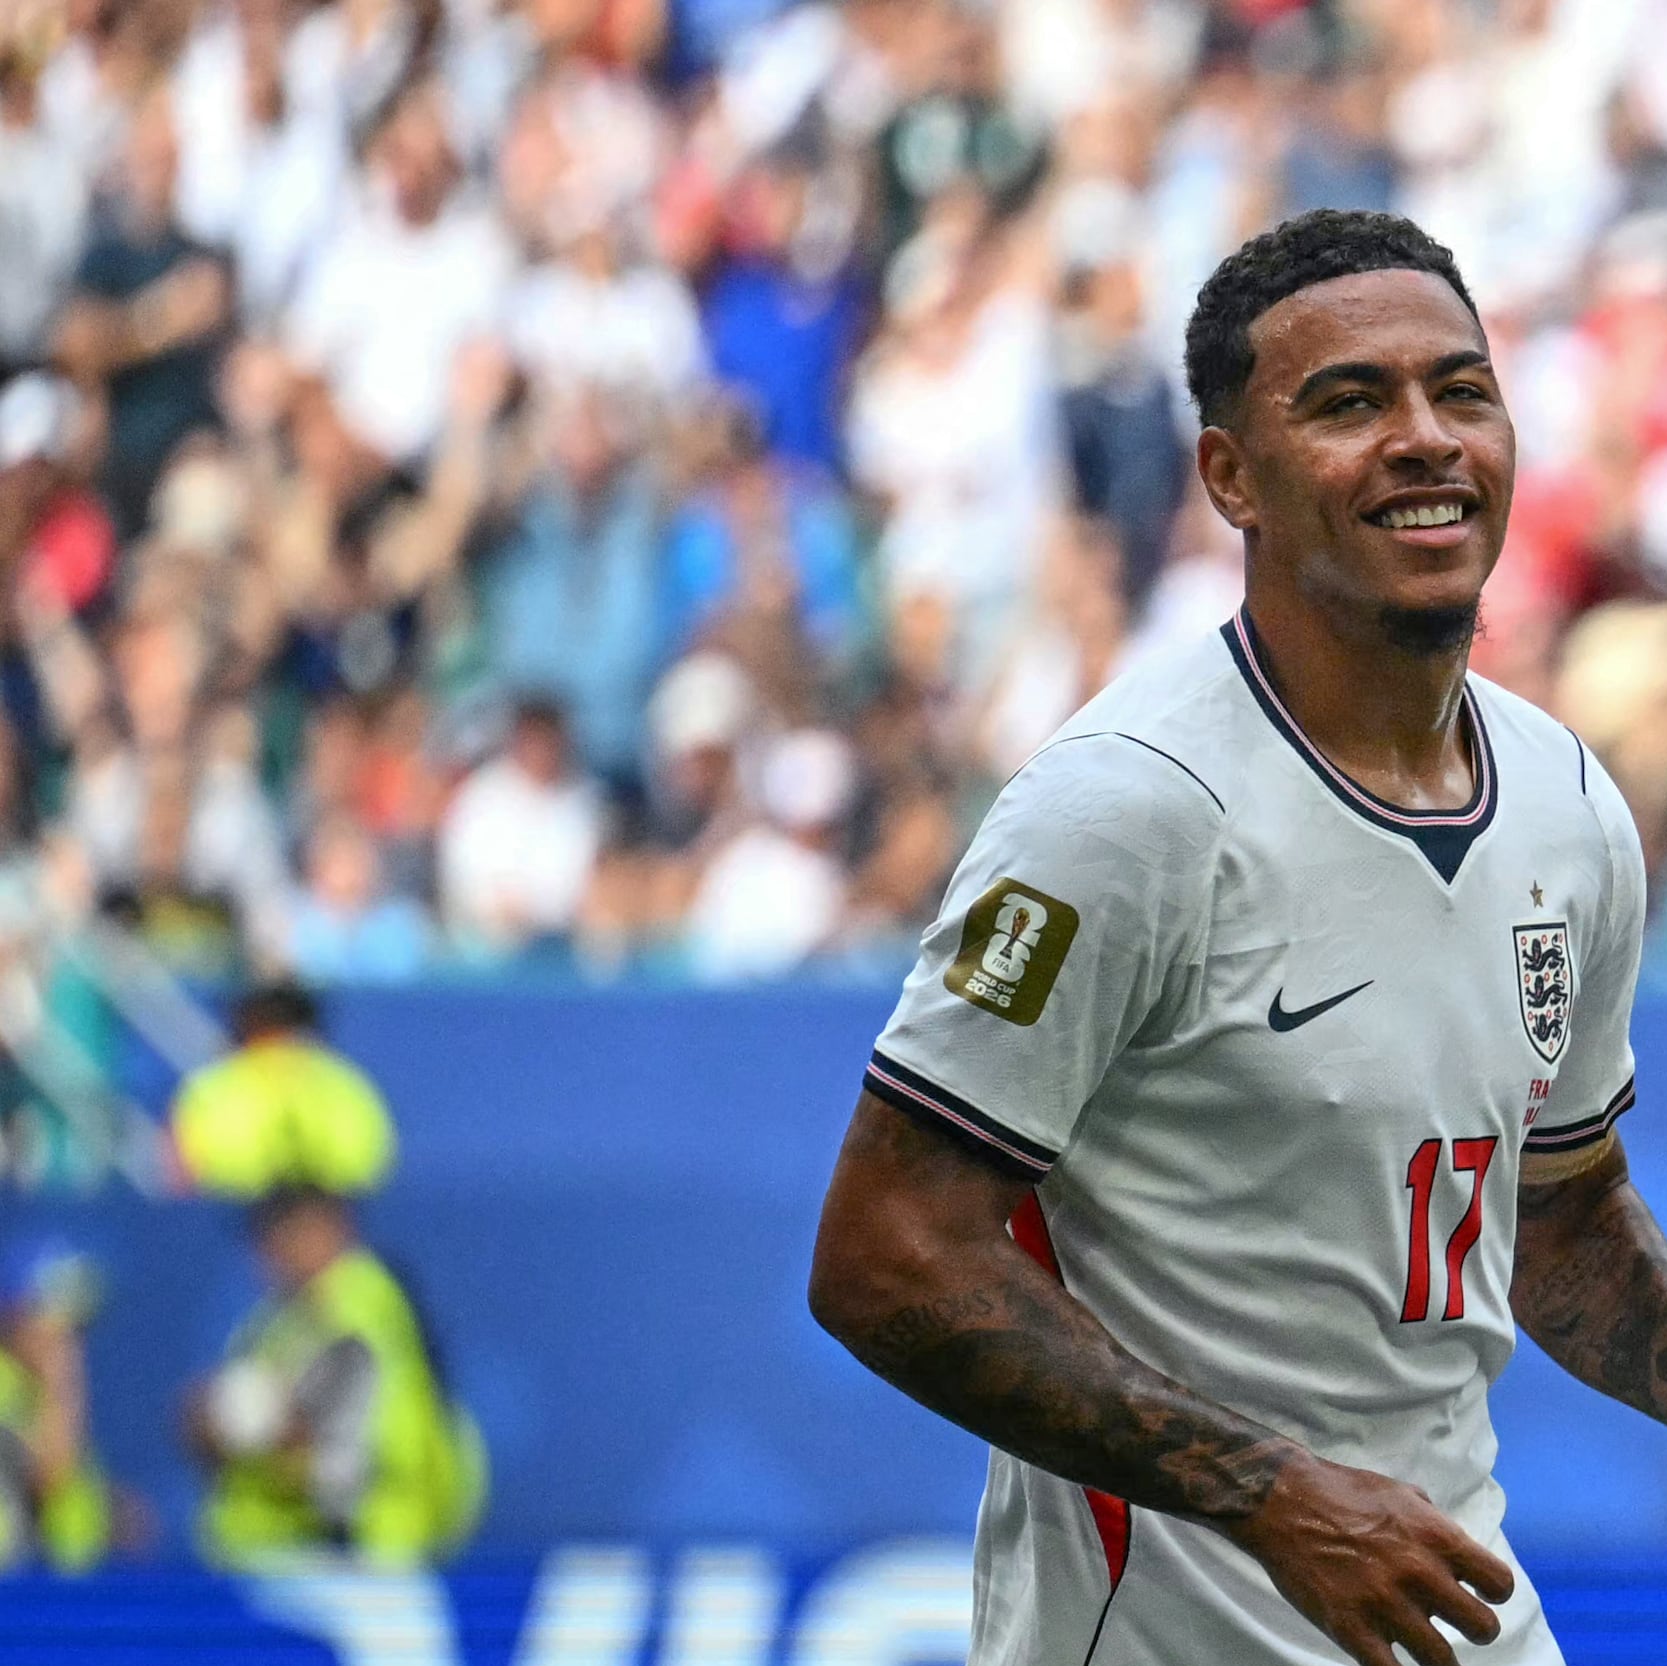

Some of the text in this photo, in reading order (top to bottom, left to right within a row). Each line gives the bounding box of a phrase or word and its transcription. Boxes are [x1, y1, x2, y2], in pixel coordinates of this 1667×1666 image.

[992, 958, 1010, 974] FIFA
[965, 978, 1011, 1008] 2026
[973, 969, 1016, 995] WORLD CUP
[1528, 1079, 1551, 1101] FRA
[1400, 1136, 1498, 1323] 17
